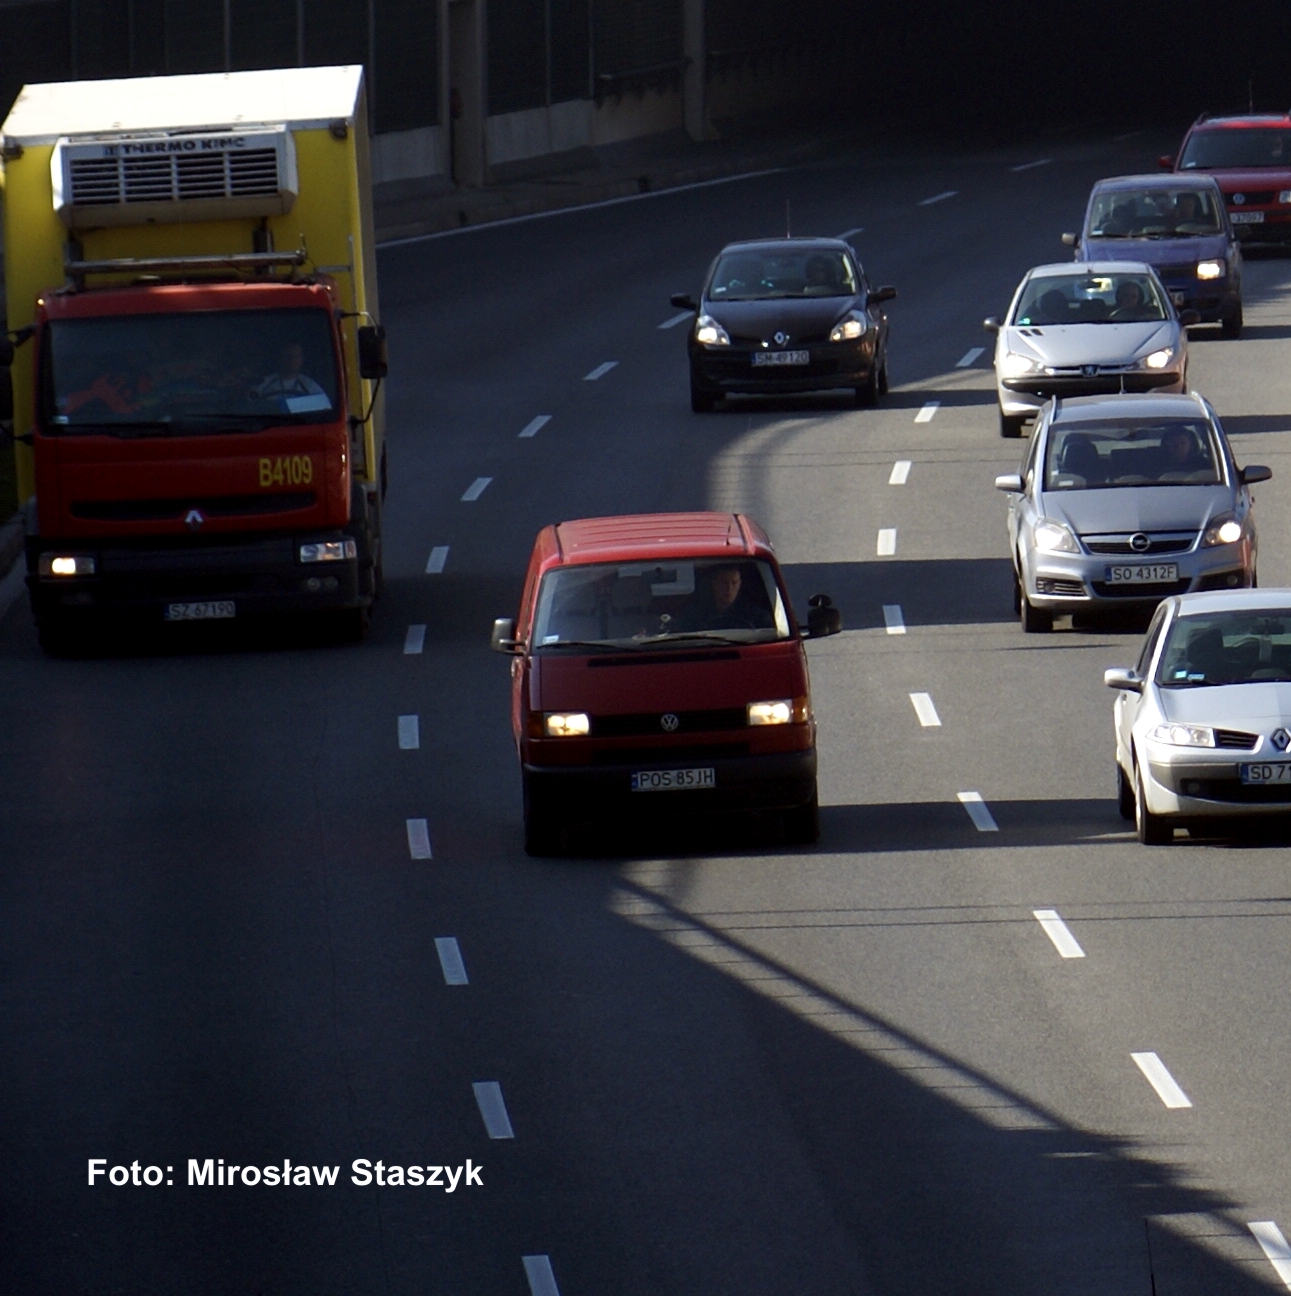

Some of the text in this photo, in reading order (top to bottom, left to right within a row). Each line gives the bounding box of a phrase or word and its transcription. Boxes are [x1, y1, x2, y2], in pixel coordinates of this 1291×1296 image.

[123, 141, 196, 154] THERMO
[258, 456, 312, 487] B4109
[1114, 566, 1174, 580] SO 4312F
[171, 602, 233, 618] SZ 67190
[640, 769, 713, 786] POS 85JH
[1251, 766, 1272, 780] SD
